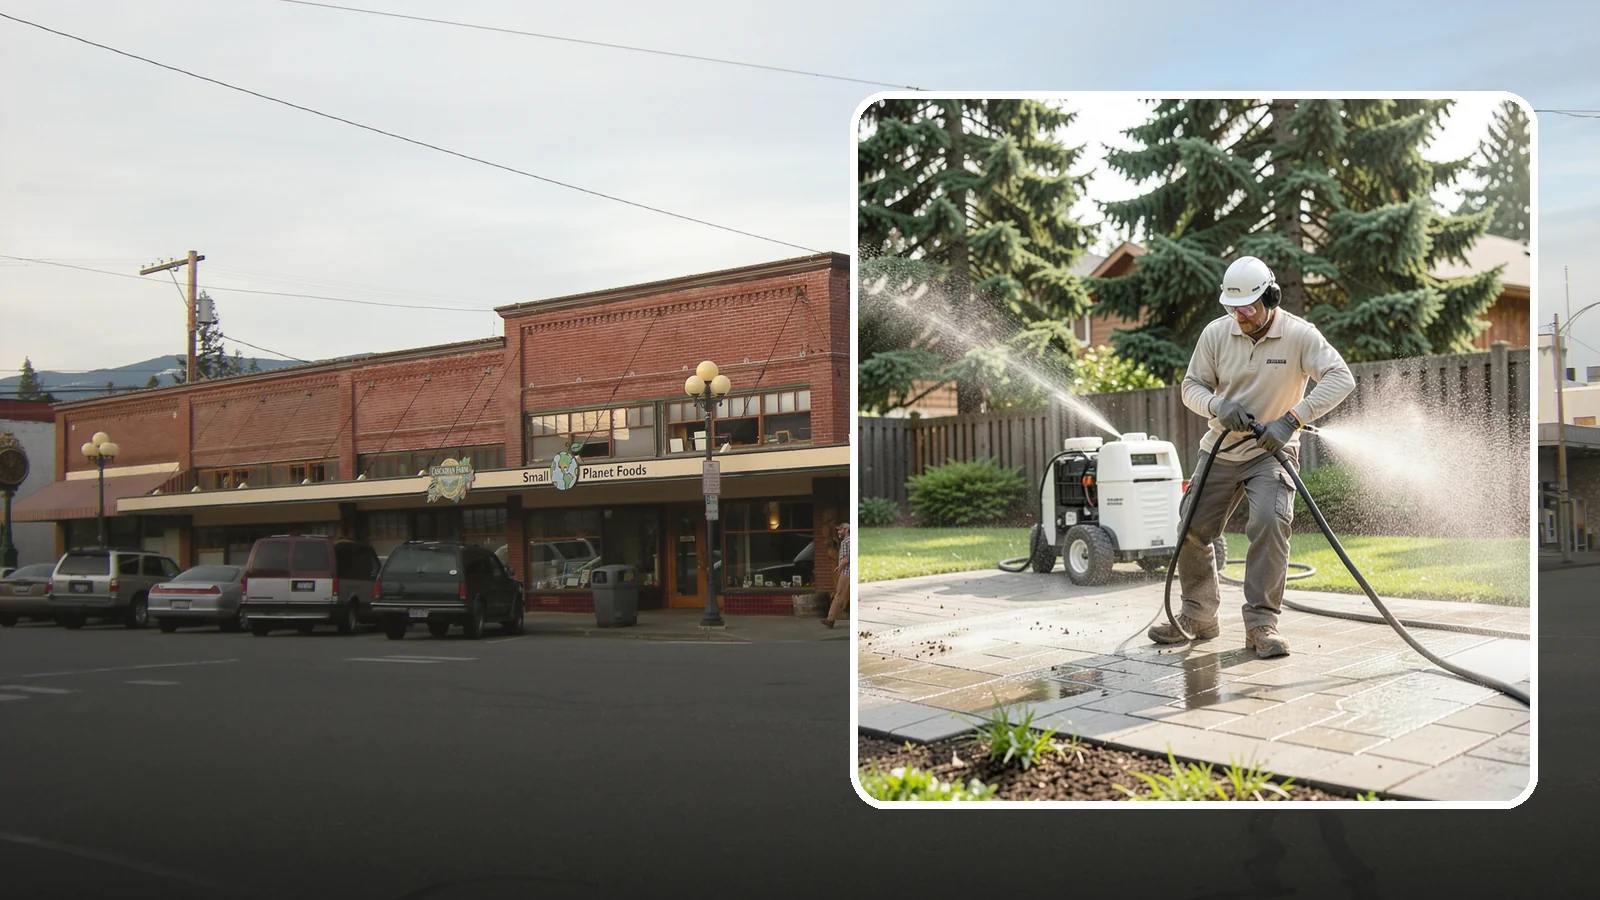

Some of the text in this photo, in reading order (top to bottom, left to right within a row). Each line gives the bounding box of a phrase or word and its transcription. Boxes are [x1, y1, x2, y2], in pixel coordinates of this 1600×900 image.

[523, 464, 647, 483] Small Planet Foods
